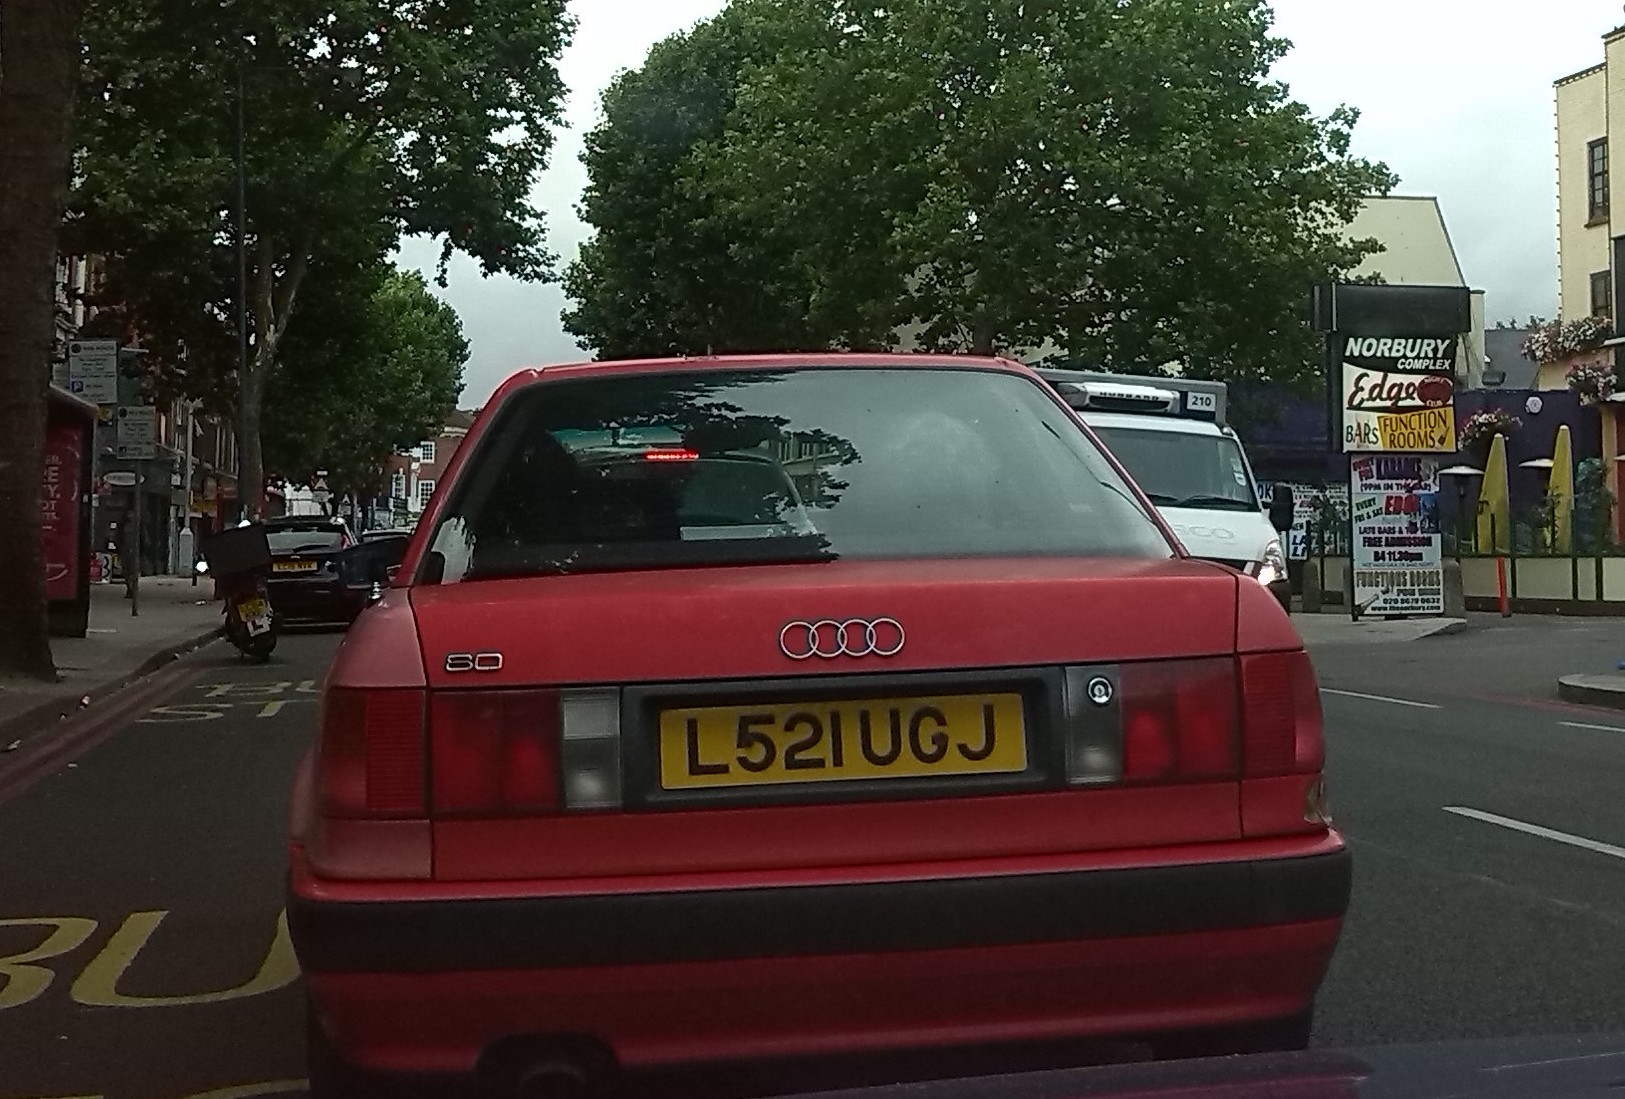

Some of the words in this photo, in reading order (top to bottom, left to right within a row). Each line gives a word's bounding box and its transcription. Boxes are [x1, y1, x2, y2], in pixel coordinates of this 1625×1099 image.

[1344, 337, 1450, 358] NORBURY
[1397, 358, 1451, 370] COMPLEX
[1191, 395, 1212, 407] 210
[1383, 410, 1448, 433] FUNCTION
[1345, 421, 1379, 446] BARS
[1389, 430, 1436, 449] ROOMS
[1362, 536, 1383, 547] FREE
[1385, 536, 1432, 547] ADMISSION
